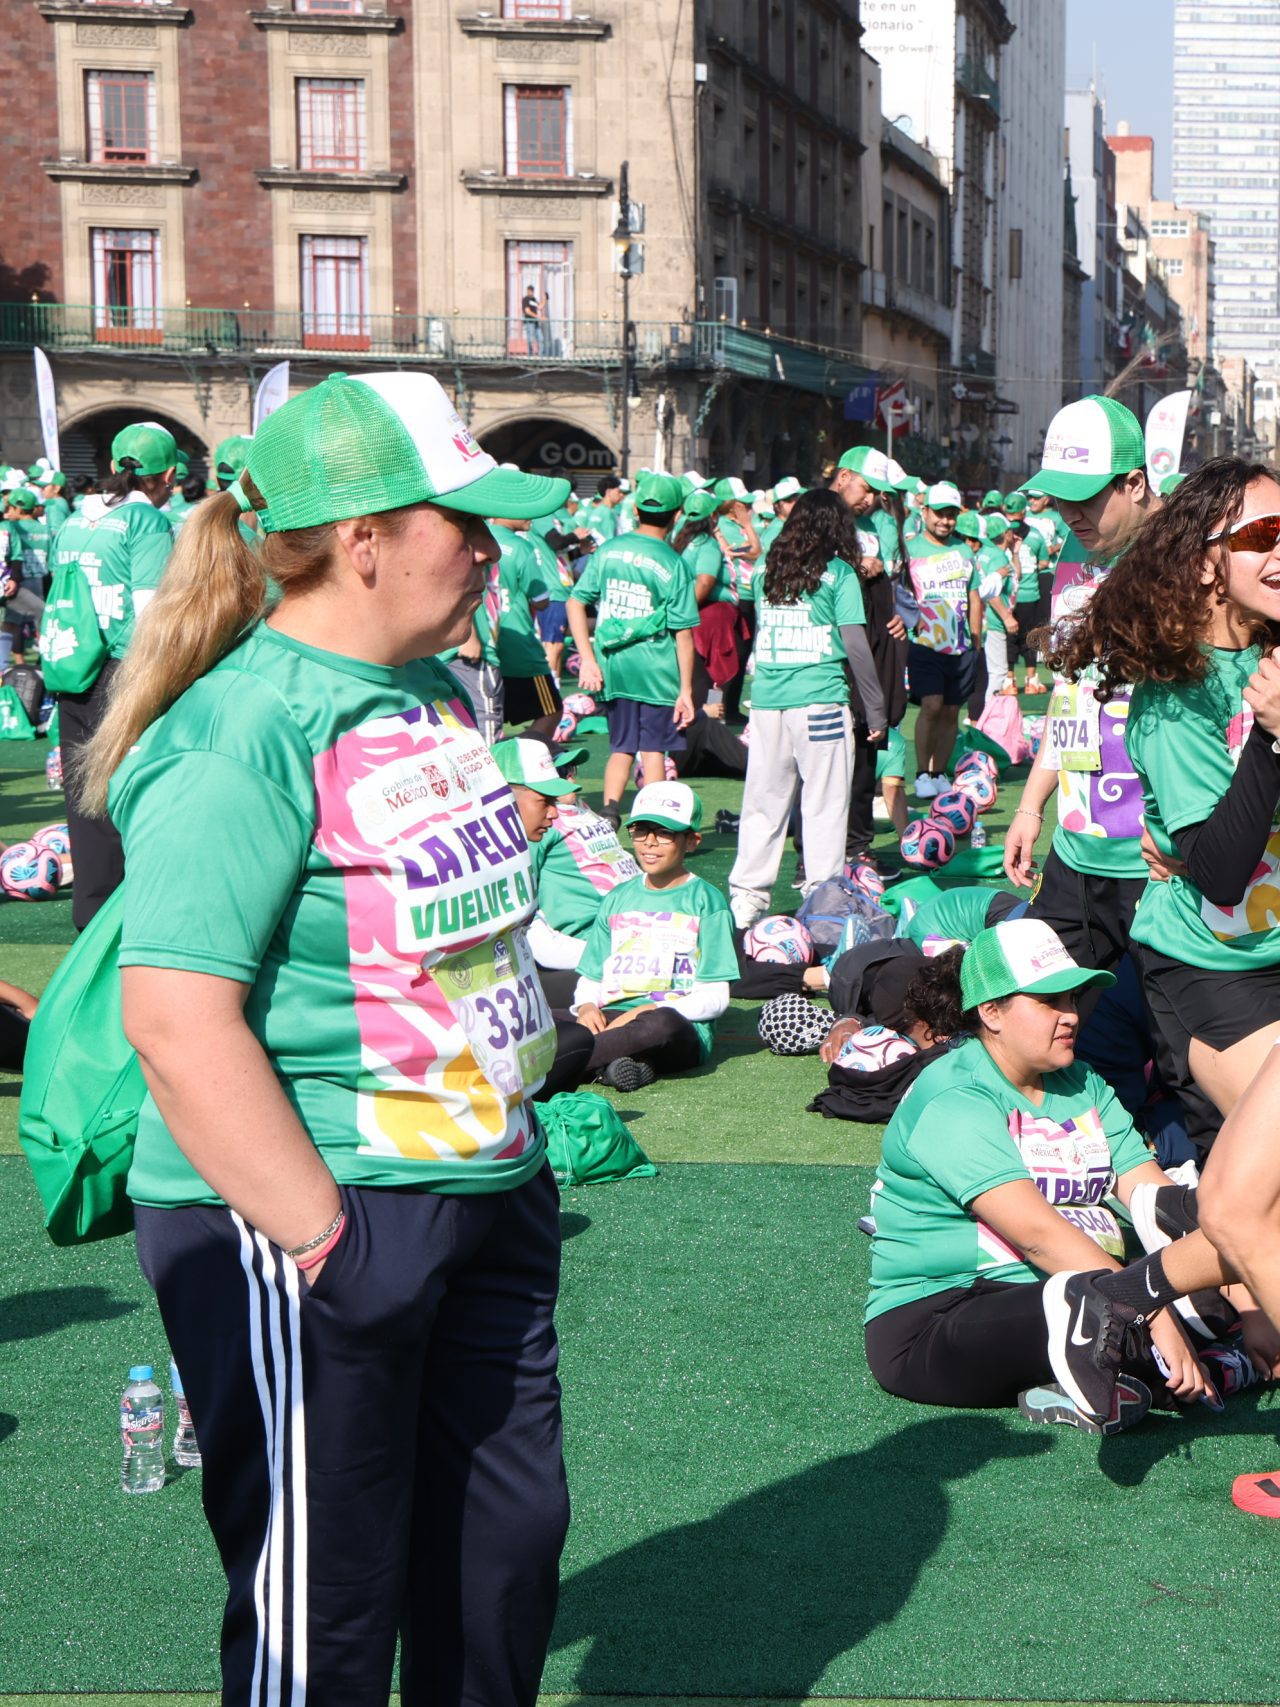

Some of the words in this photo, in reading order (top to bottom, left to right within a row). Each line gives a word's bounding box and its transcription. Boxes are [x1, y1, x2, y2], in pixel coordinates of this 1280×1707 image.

[862, 19, 914, 31] ionario
[1052, 719, 1089, 749] 5074
[396, 835, 464, 890] LA
[454, 801, 529, 874] PELO
[410, 877, 516, 940] VUELVE
[612, 955, 661, 976] 2254
[475, 974, 543, 1050] 3327
